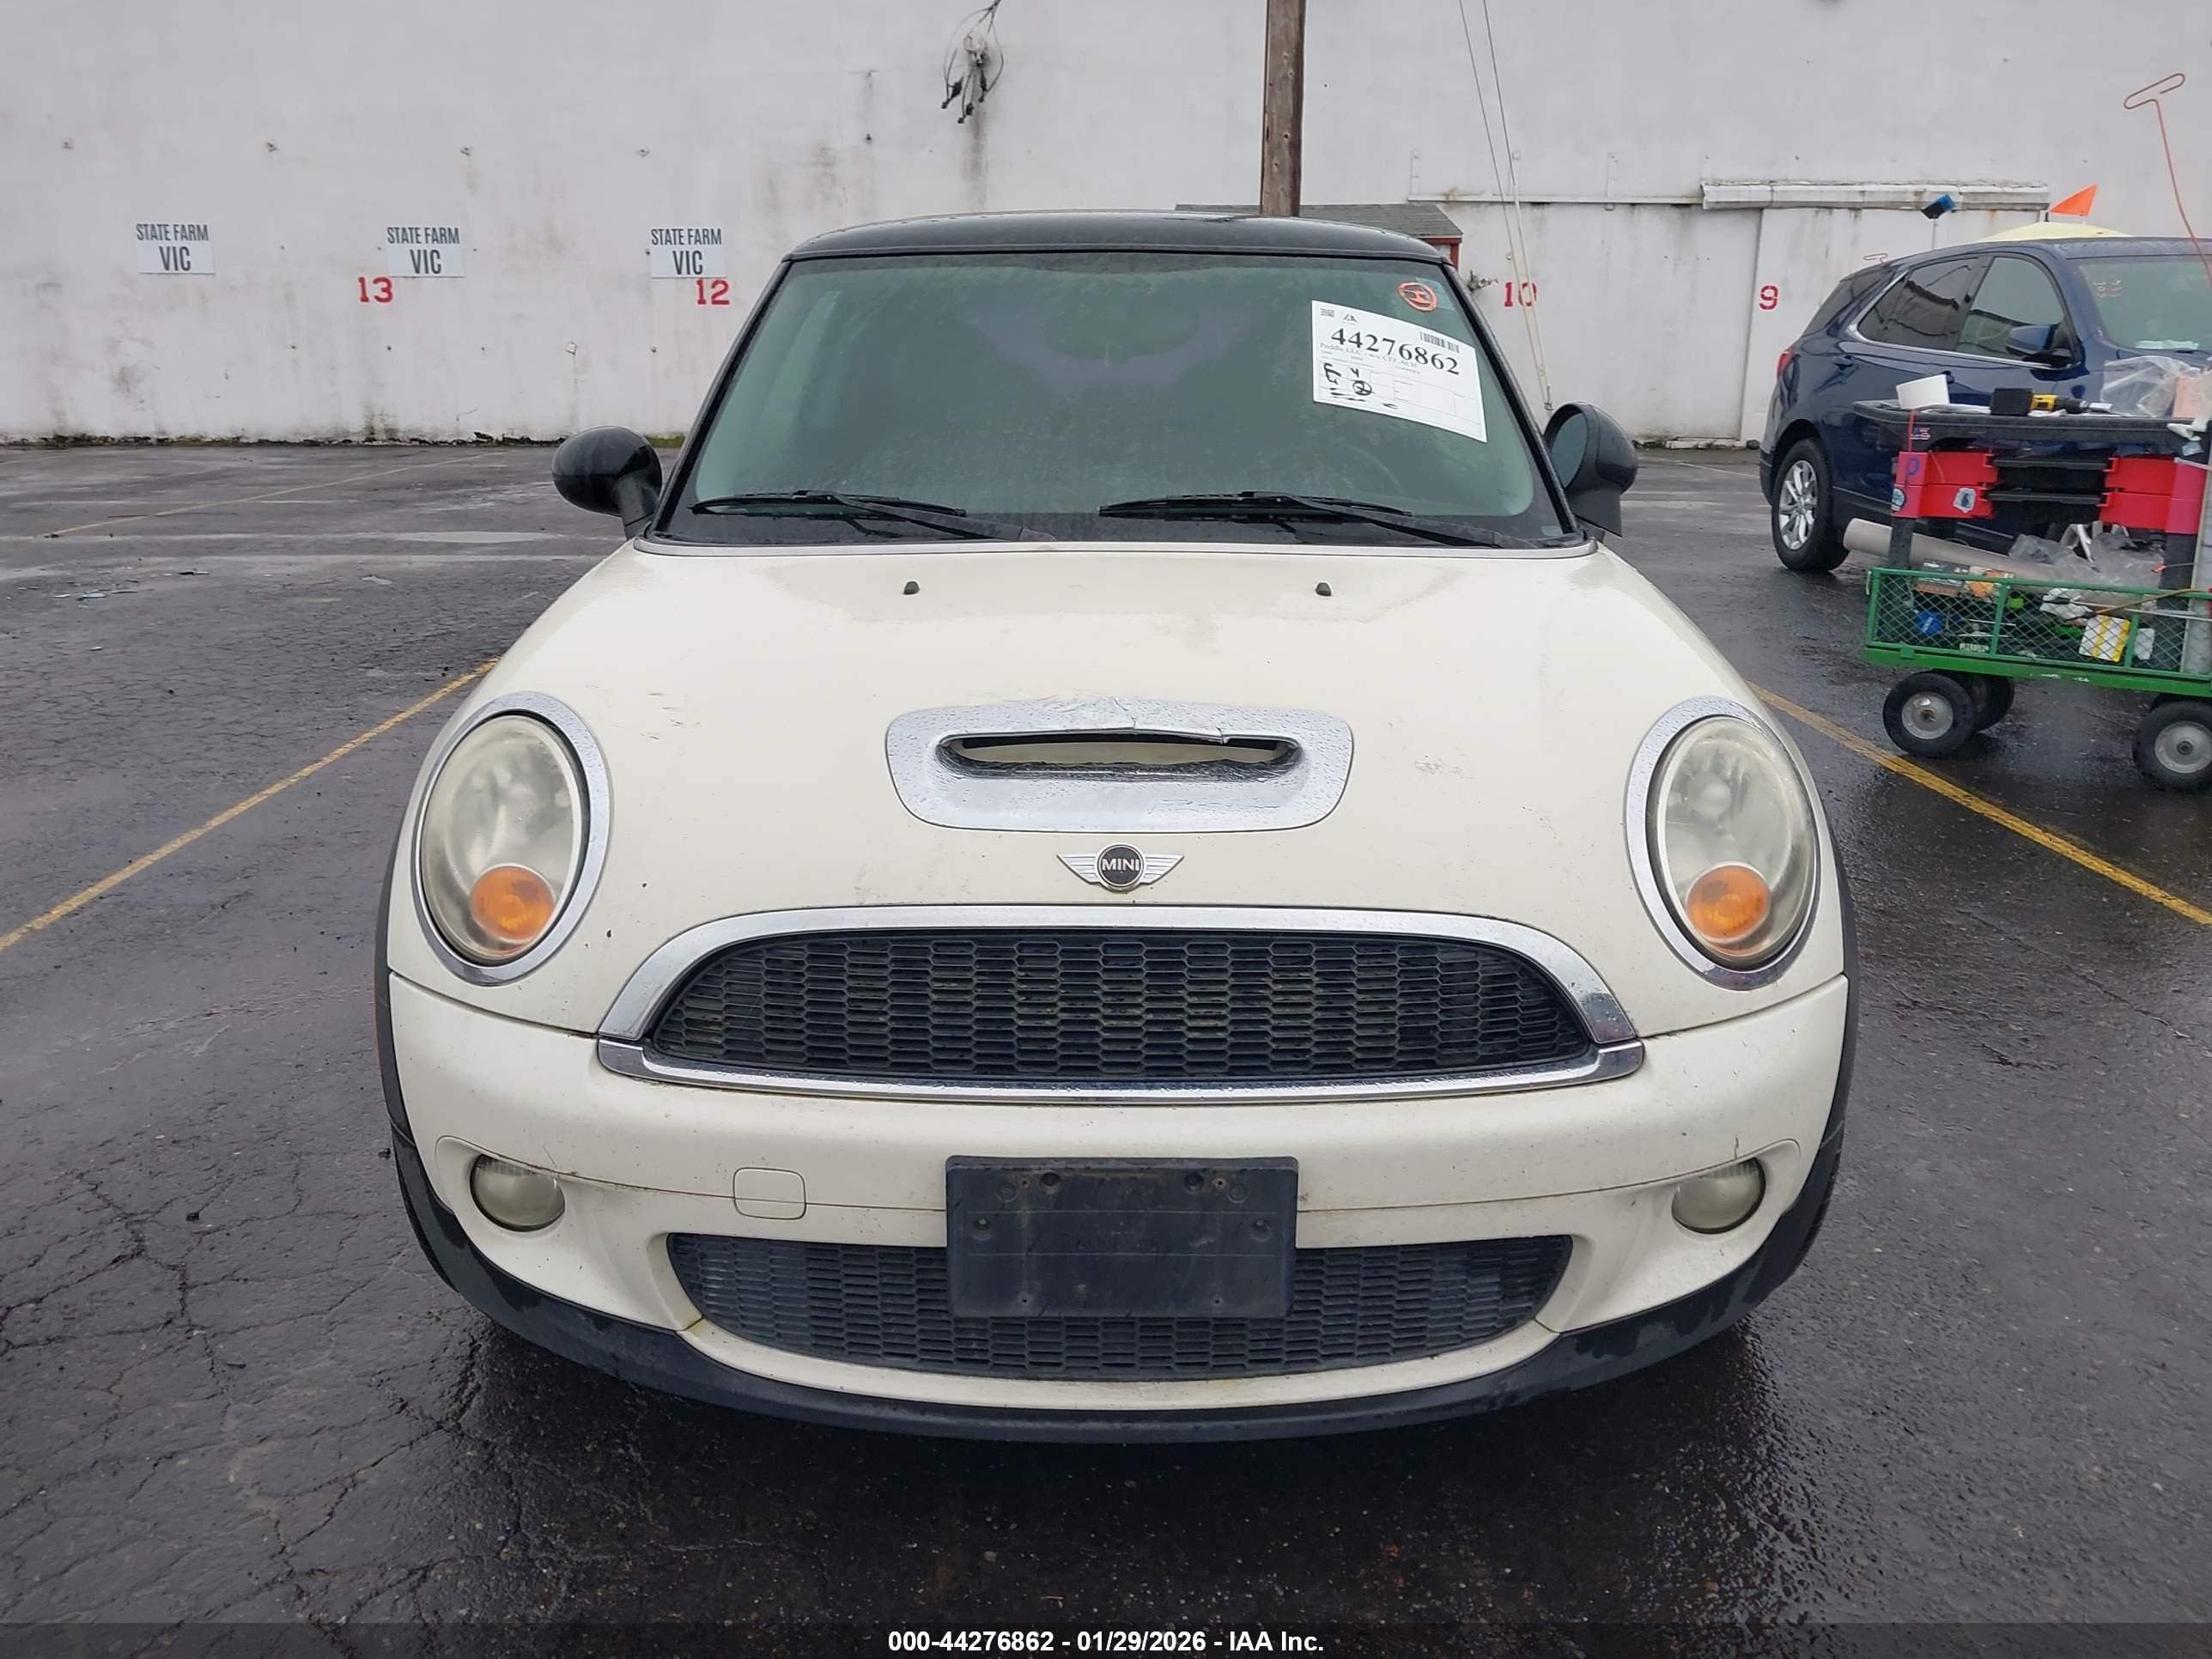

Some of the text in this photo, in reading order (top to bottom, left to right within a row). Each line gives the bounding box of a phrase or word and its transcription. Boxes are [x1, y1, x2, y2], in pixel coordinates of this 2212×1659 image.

[136, 223, 209, 241] STATE FARM
[386, 227, 460, 244] STATE FARM
[651, 228, 722, 246] STATE FARM
[158, 246, 191, 271] VIC
[410, 249, 442, 274] VIC
[672, 250, 703, 276] VIC
[358, 276, 393, 303] 13
[696, 278, 730, 305] 12
[1504, 282, 1537, 307] 10
[1759, 285, 1778, 310] 9
[1331, 328, 1460, 375] 44276862
[1102, 858, 1139, 872] MINI
